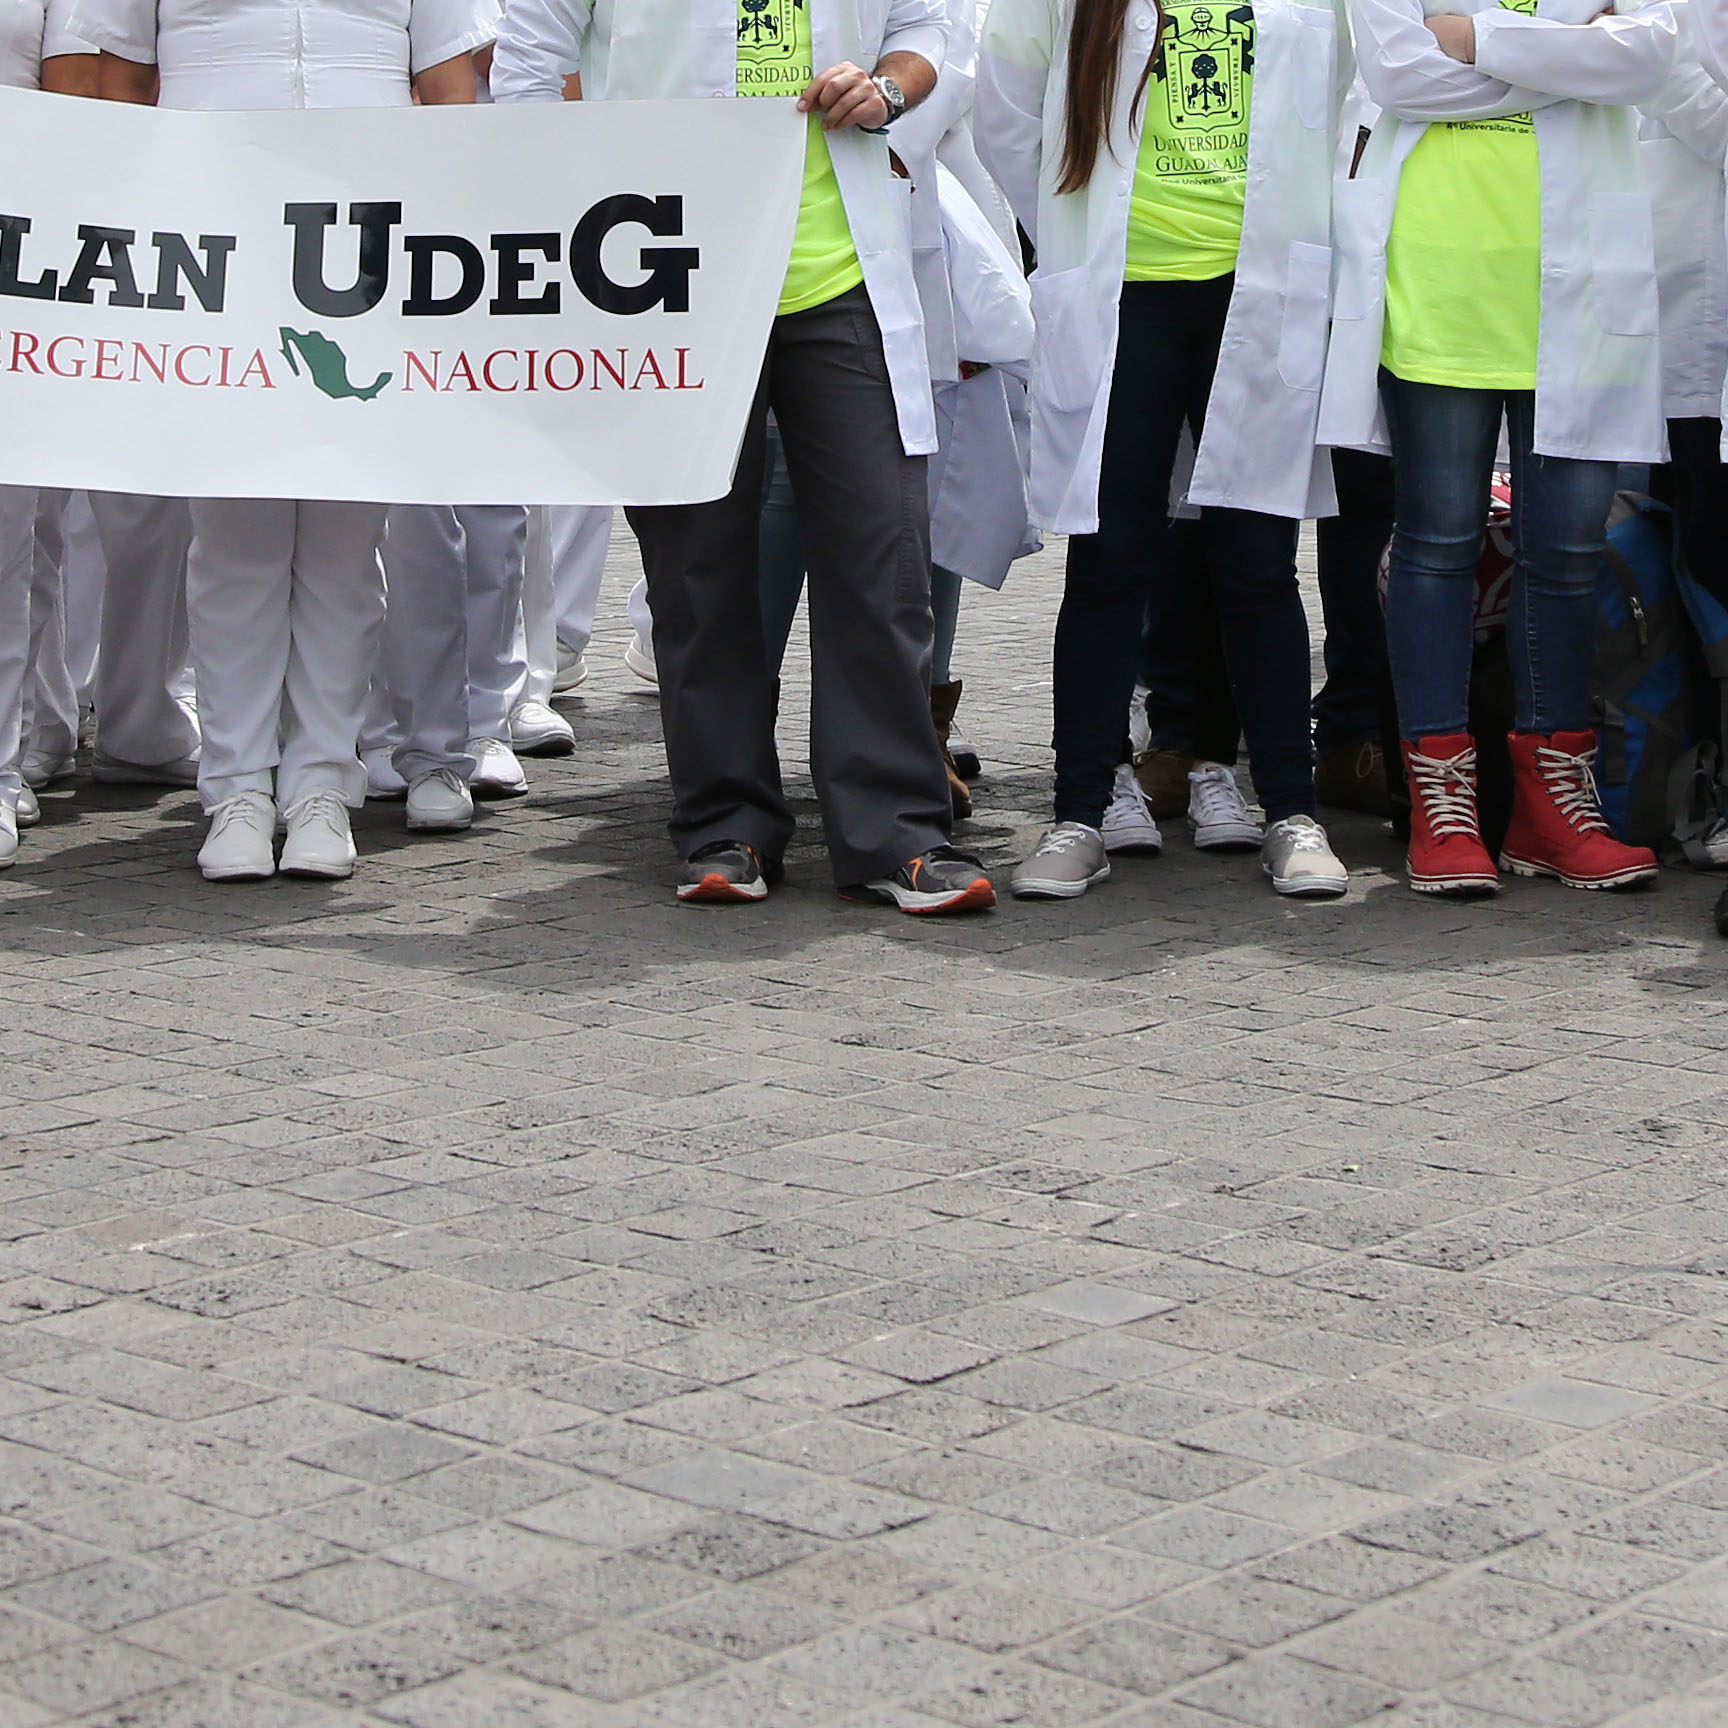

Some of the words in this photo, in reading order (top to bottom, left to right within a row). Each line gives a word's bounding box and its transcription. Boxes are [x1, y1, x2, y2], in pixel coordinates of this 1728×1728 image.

[735, 66, 800, 83] ERSIDAD
[1155, 153, 1248, 173] GUADALAJA
[401, 346, 705, 393] NACIONAL
